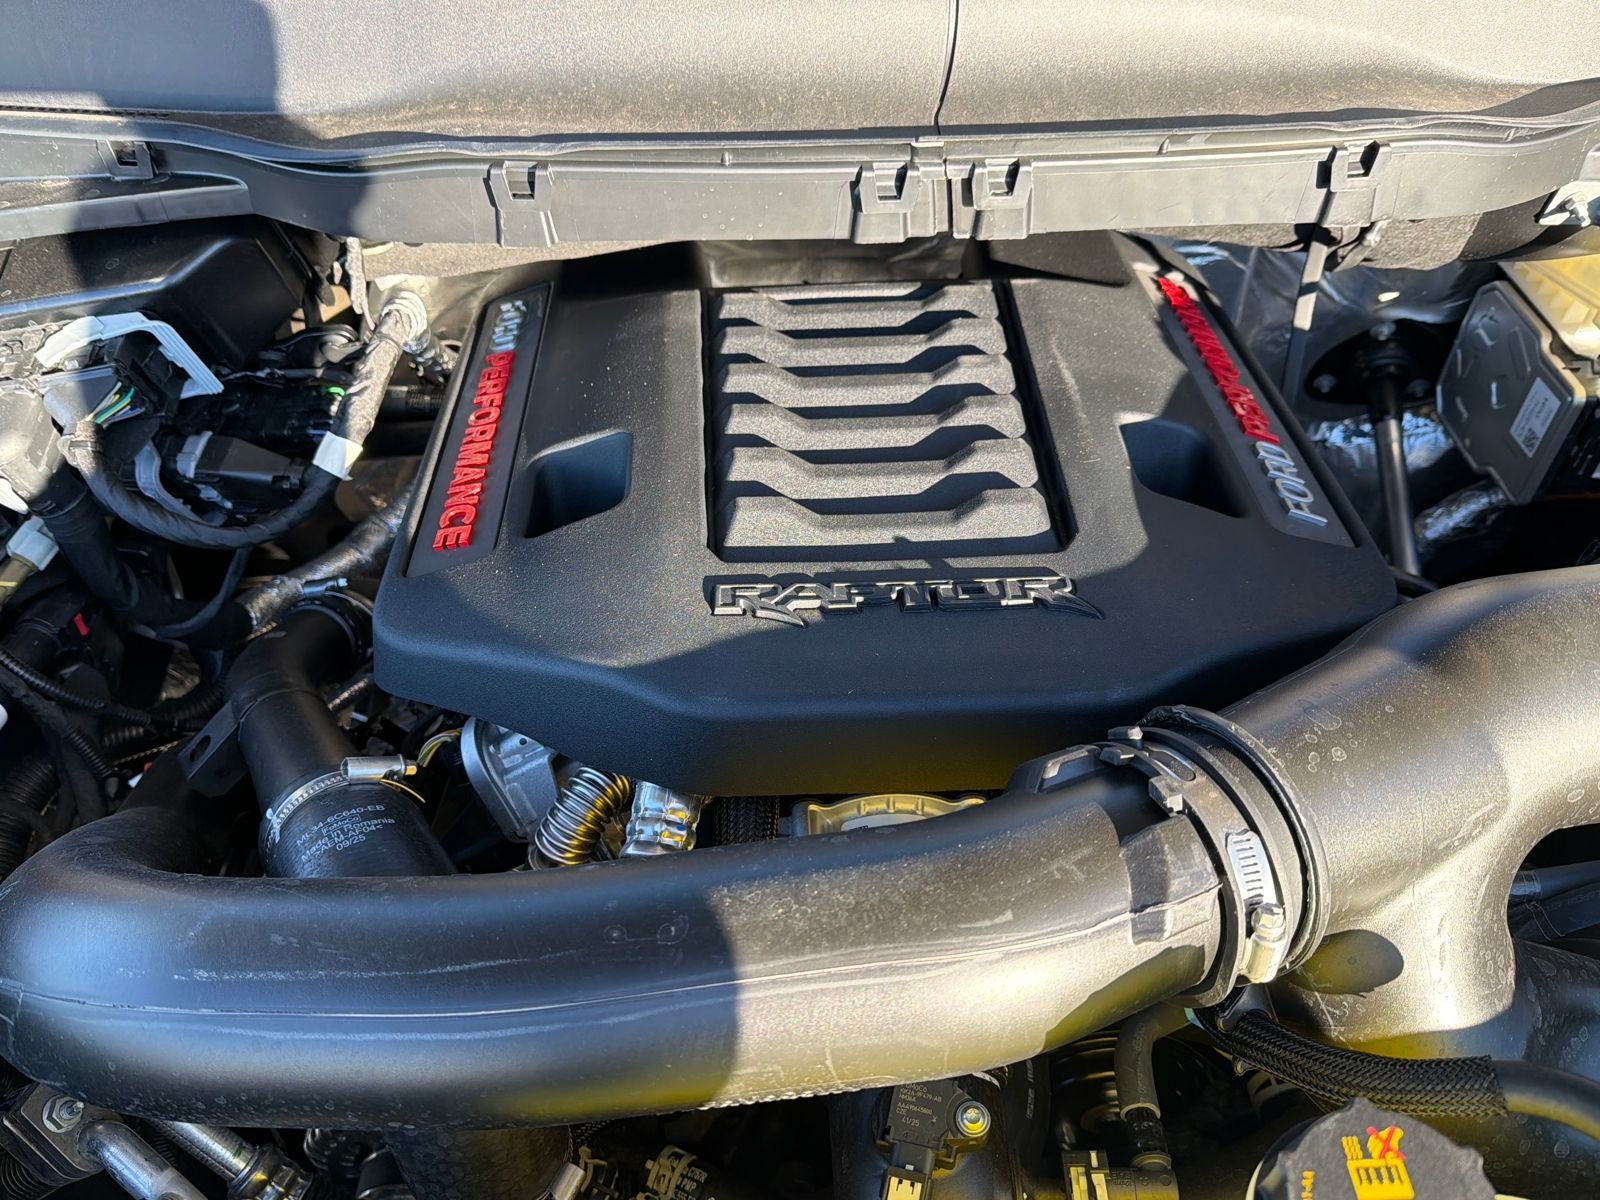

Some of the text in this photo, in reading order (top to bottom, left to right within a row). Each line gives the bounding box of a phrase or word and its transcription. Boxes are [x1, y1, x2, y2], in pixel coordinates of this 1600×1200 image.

[432, 350, 516, 551] PERFORMANCE
[1255, 441, 1329, 527] FORD
[711, 574, 1104, 628] RAPTOR
[301, 817, 395, 863] Made in Romania
[322, 815, 361, 835] FoMoCo
[336, 835, 366, 851] 09/25
[902, 1116, 920, 1127] 41/25
